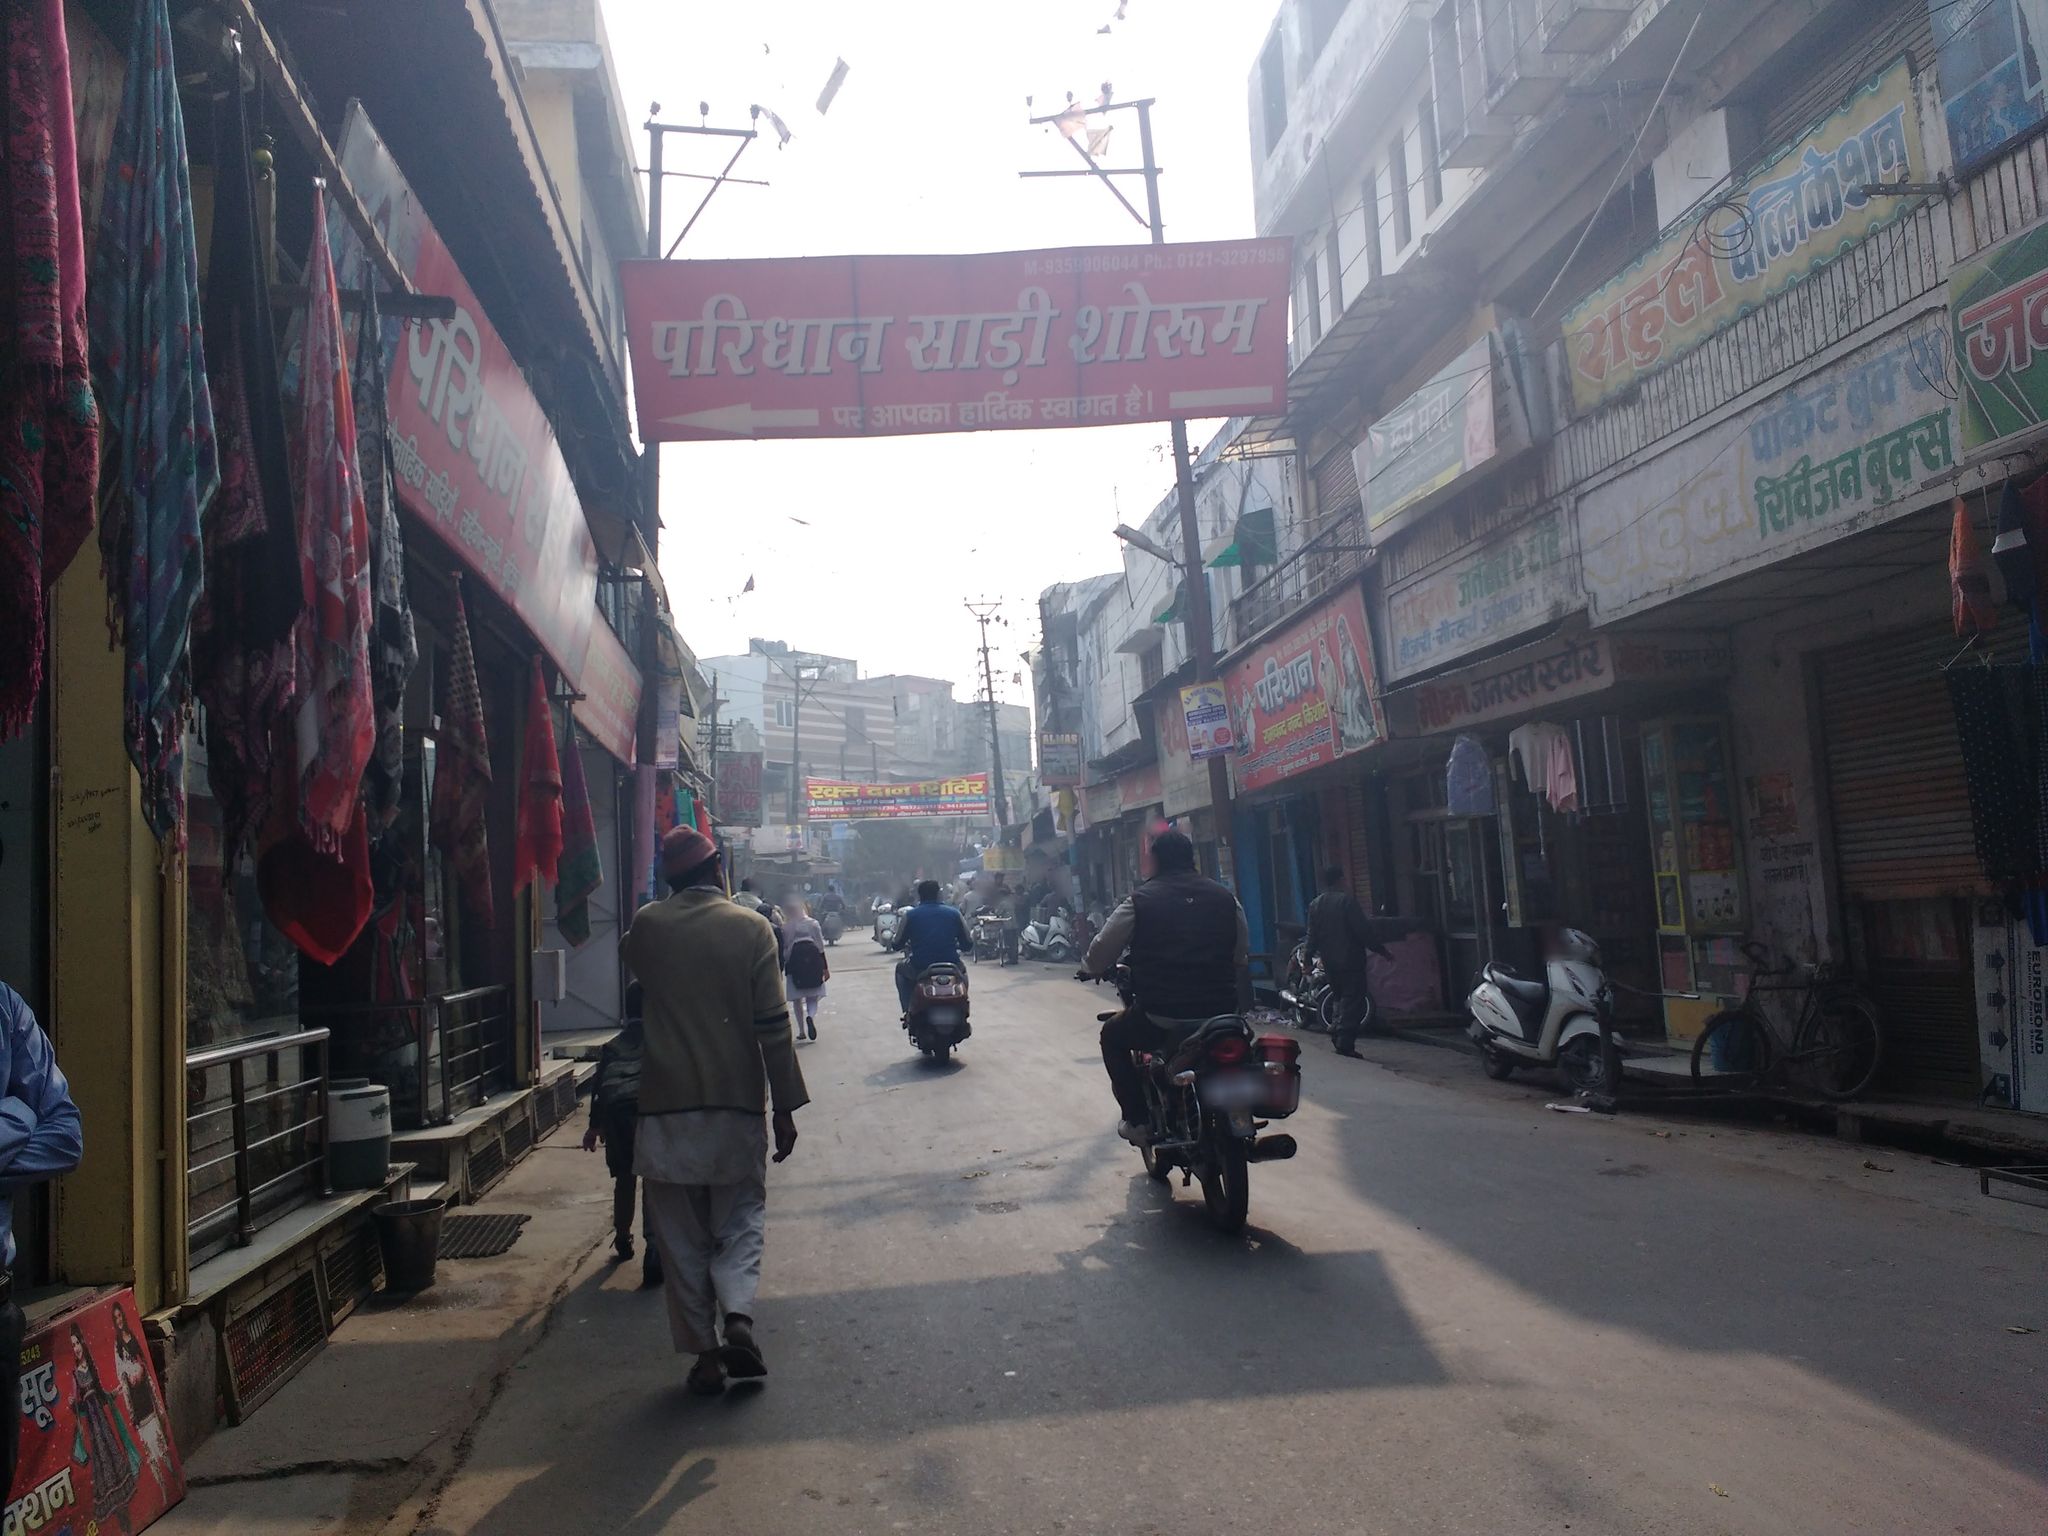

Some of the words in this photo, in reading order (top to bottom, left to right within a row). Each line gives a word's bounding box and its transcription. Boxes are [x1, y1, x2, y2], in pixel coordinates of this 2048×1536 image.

[650, 293, 894, 379] परिधान
[906, 285, 1060, 387] साड़ी
[1068, 281, 1269, 364] शोरूम
[408, 305, 529, 518] परिधान
[832, 404, 865, 428] पर
[871, 402, 952, 428] आपका
[957, 390, 1034, 426] हार्दिक
[1039, 397, 1119, 420] स्वागत
[1864, 405, 1955, 505] बुक्स
[1254, 656, 1317, 713] परिधान
[1537, 636, 1607, 692] स्टोर
[1042, 733, 1078, 745] ALMAS
[809, 785, 861, 799] रक्त
[866, 785, 912, 797] दान
[919, 779, 986, 797] शिविर
[2031, 950, 2045, 1056] EUROBOND
[20, 1361, 59, 1429] सूट
